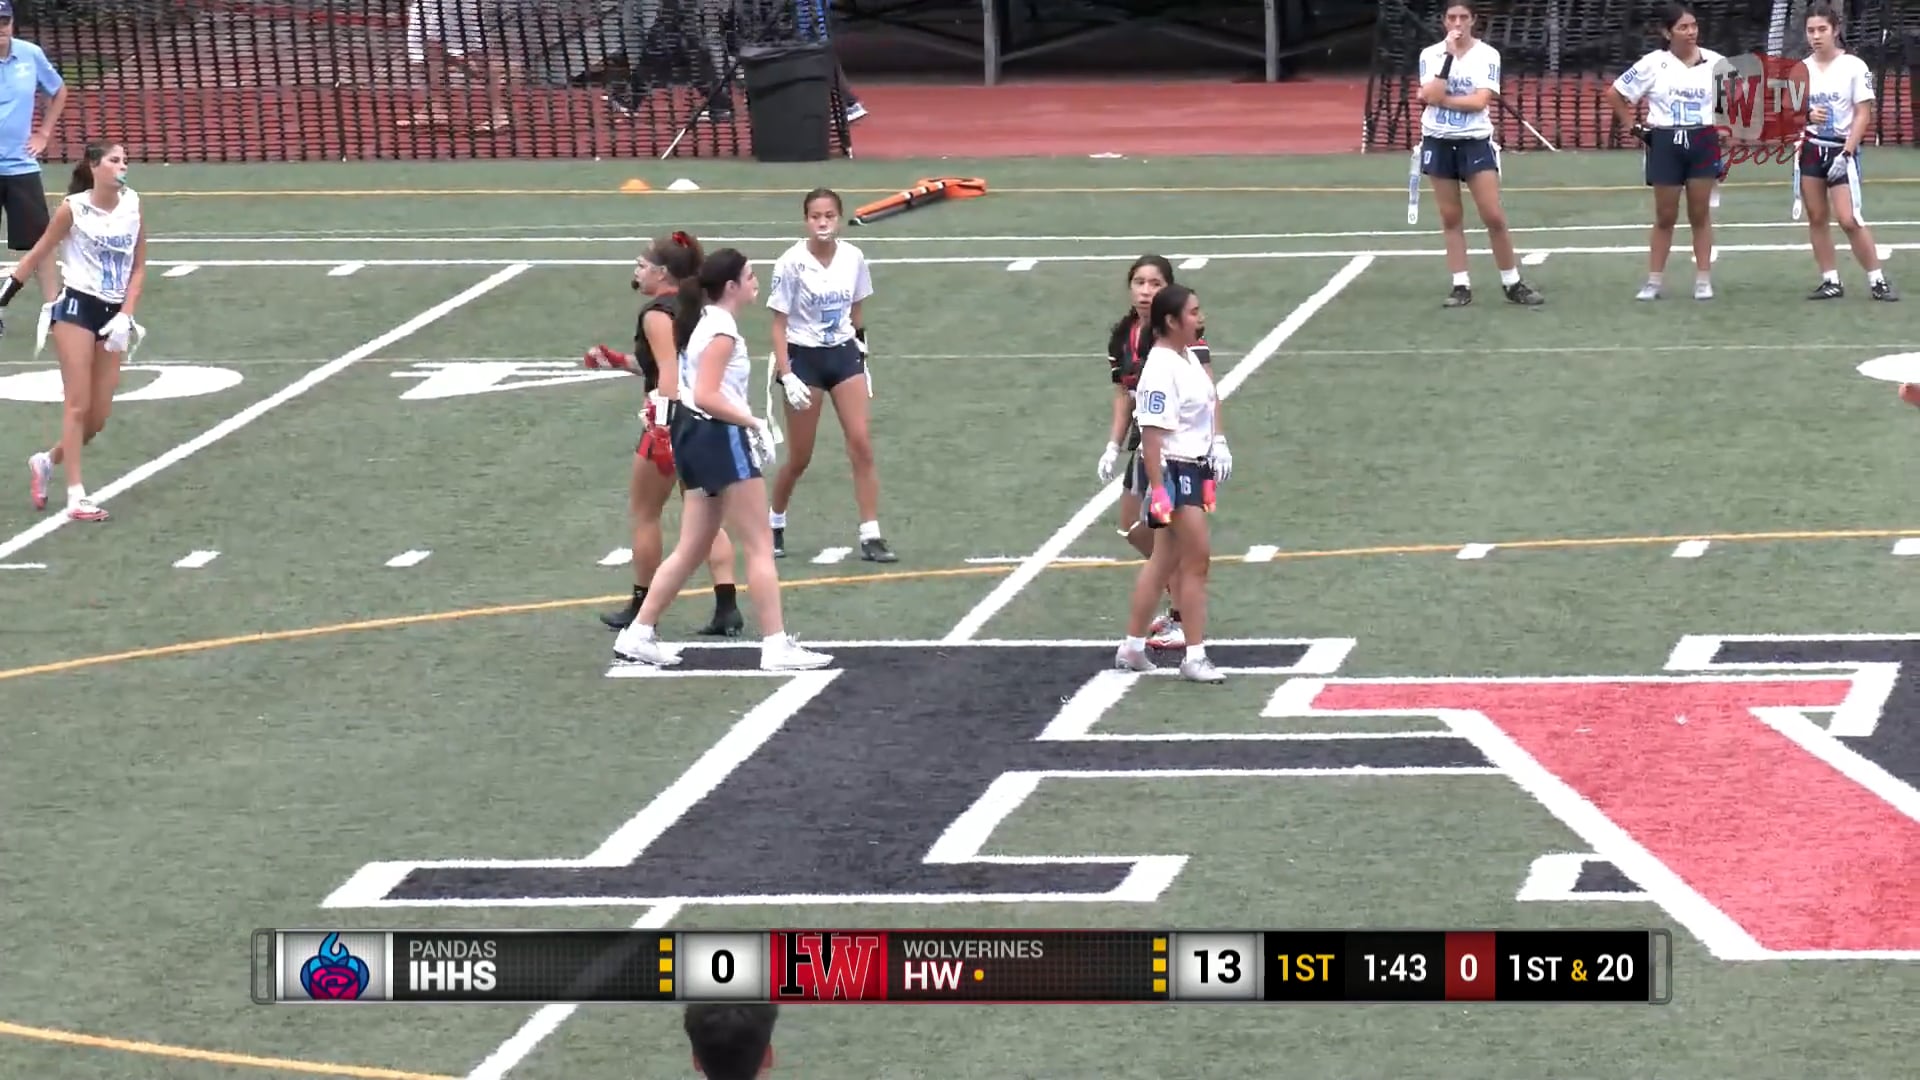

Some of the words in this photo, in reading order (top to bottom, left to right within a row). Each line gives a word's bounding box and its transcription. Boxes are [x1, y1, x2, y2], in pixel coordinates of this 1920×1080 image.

[1670, 99, 1704, 127] 15
[99, 251, 128, 291] 11
[820, 308, 842, 345] 7
